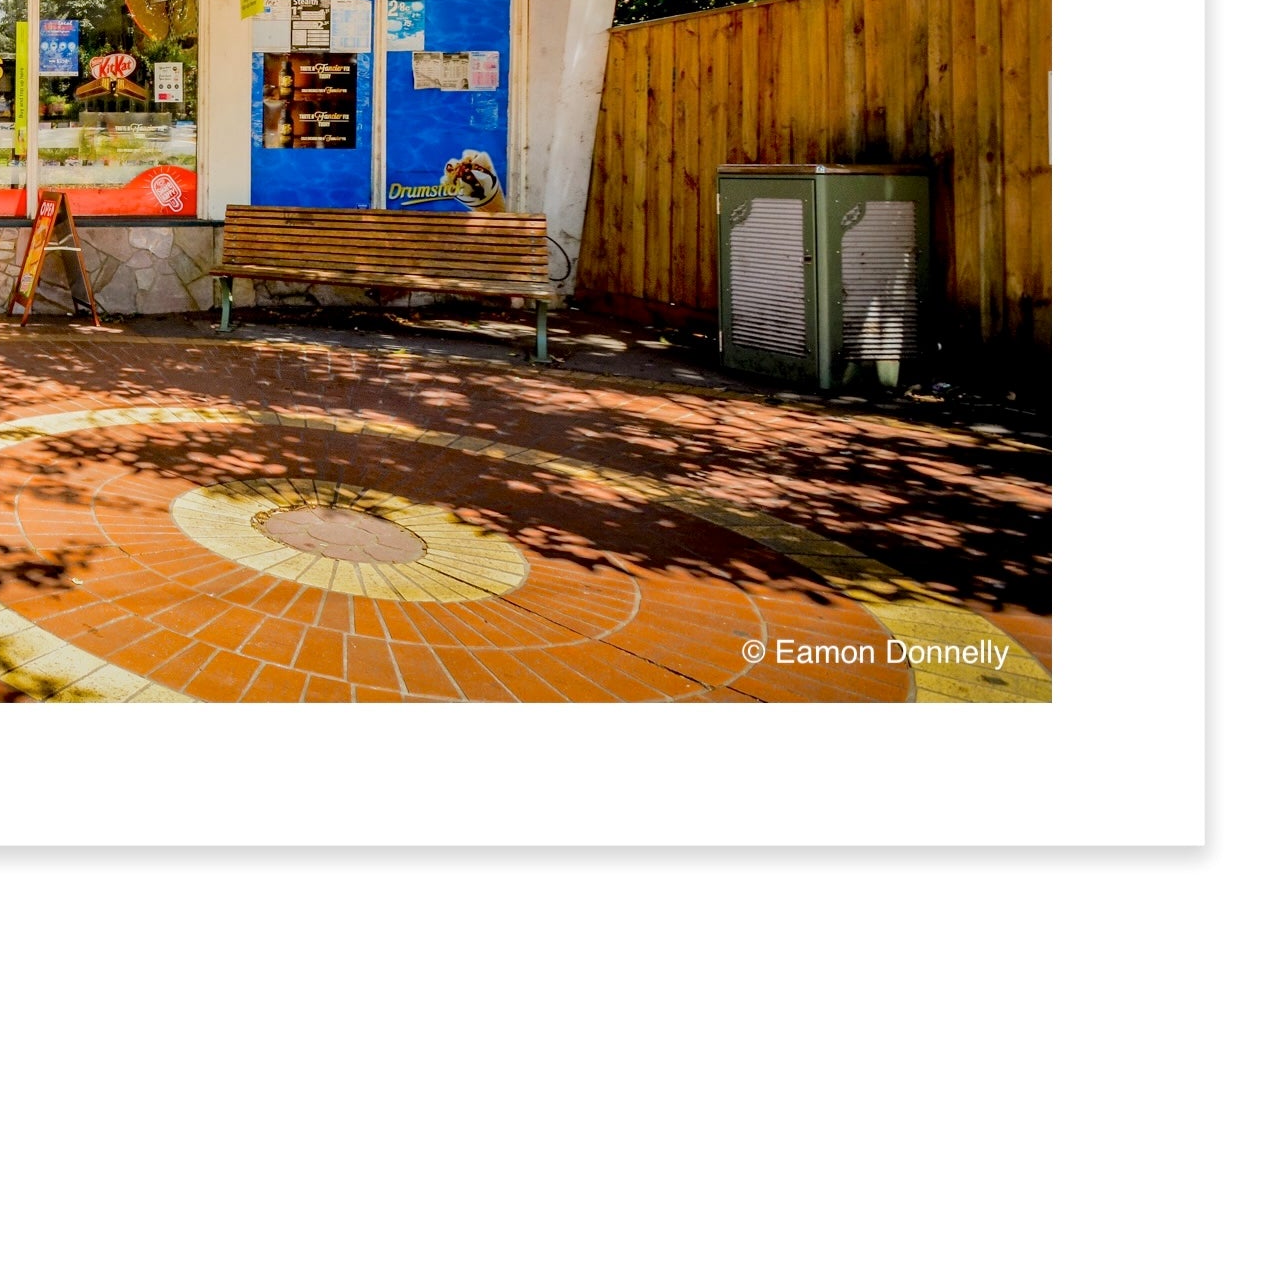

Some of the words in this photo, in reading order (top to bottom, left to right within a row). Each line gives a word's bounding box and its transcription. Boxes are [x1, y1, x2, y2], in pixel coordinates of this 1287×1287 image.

[99, 55, 132, 77] KitKat
[388, 182, 465, 200] Drumstick
[39, 200, 55, 217] OPEN
